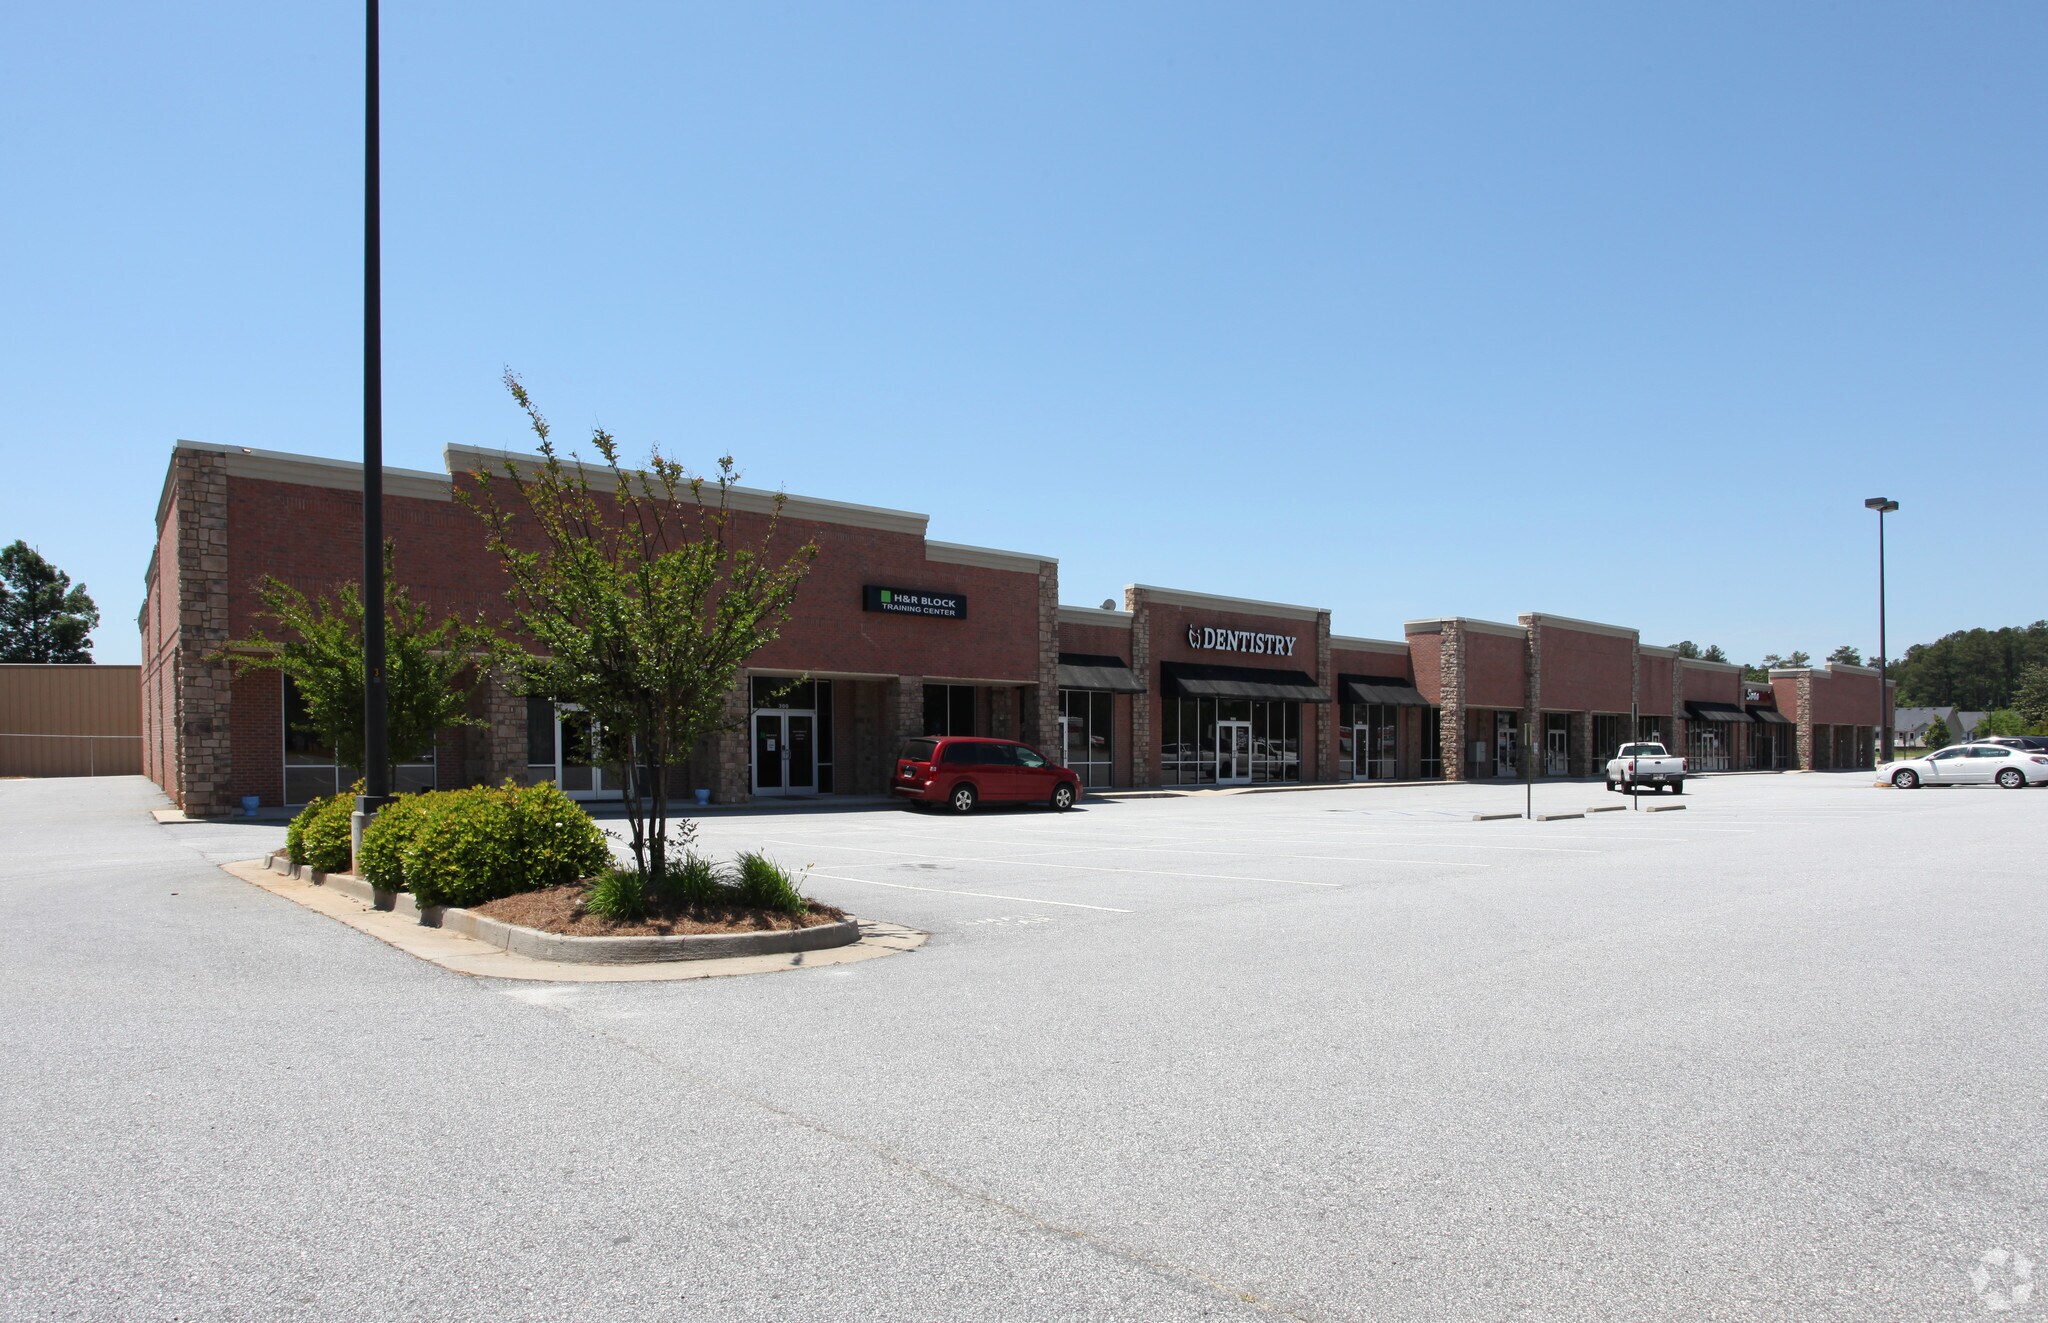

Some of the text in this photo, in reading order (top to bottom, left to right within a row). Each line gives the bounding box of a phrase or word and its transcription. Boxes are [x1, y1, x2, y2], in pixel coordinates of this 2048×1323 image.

[894, 594, 956, 608] H&R BLOCK
[881, 603, 956, 616] TRAINING CENTER
[1203, 627, 1297, 656] DENTISTRY
